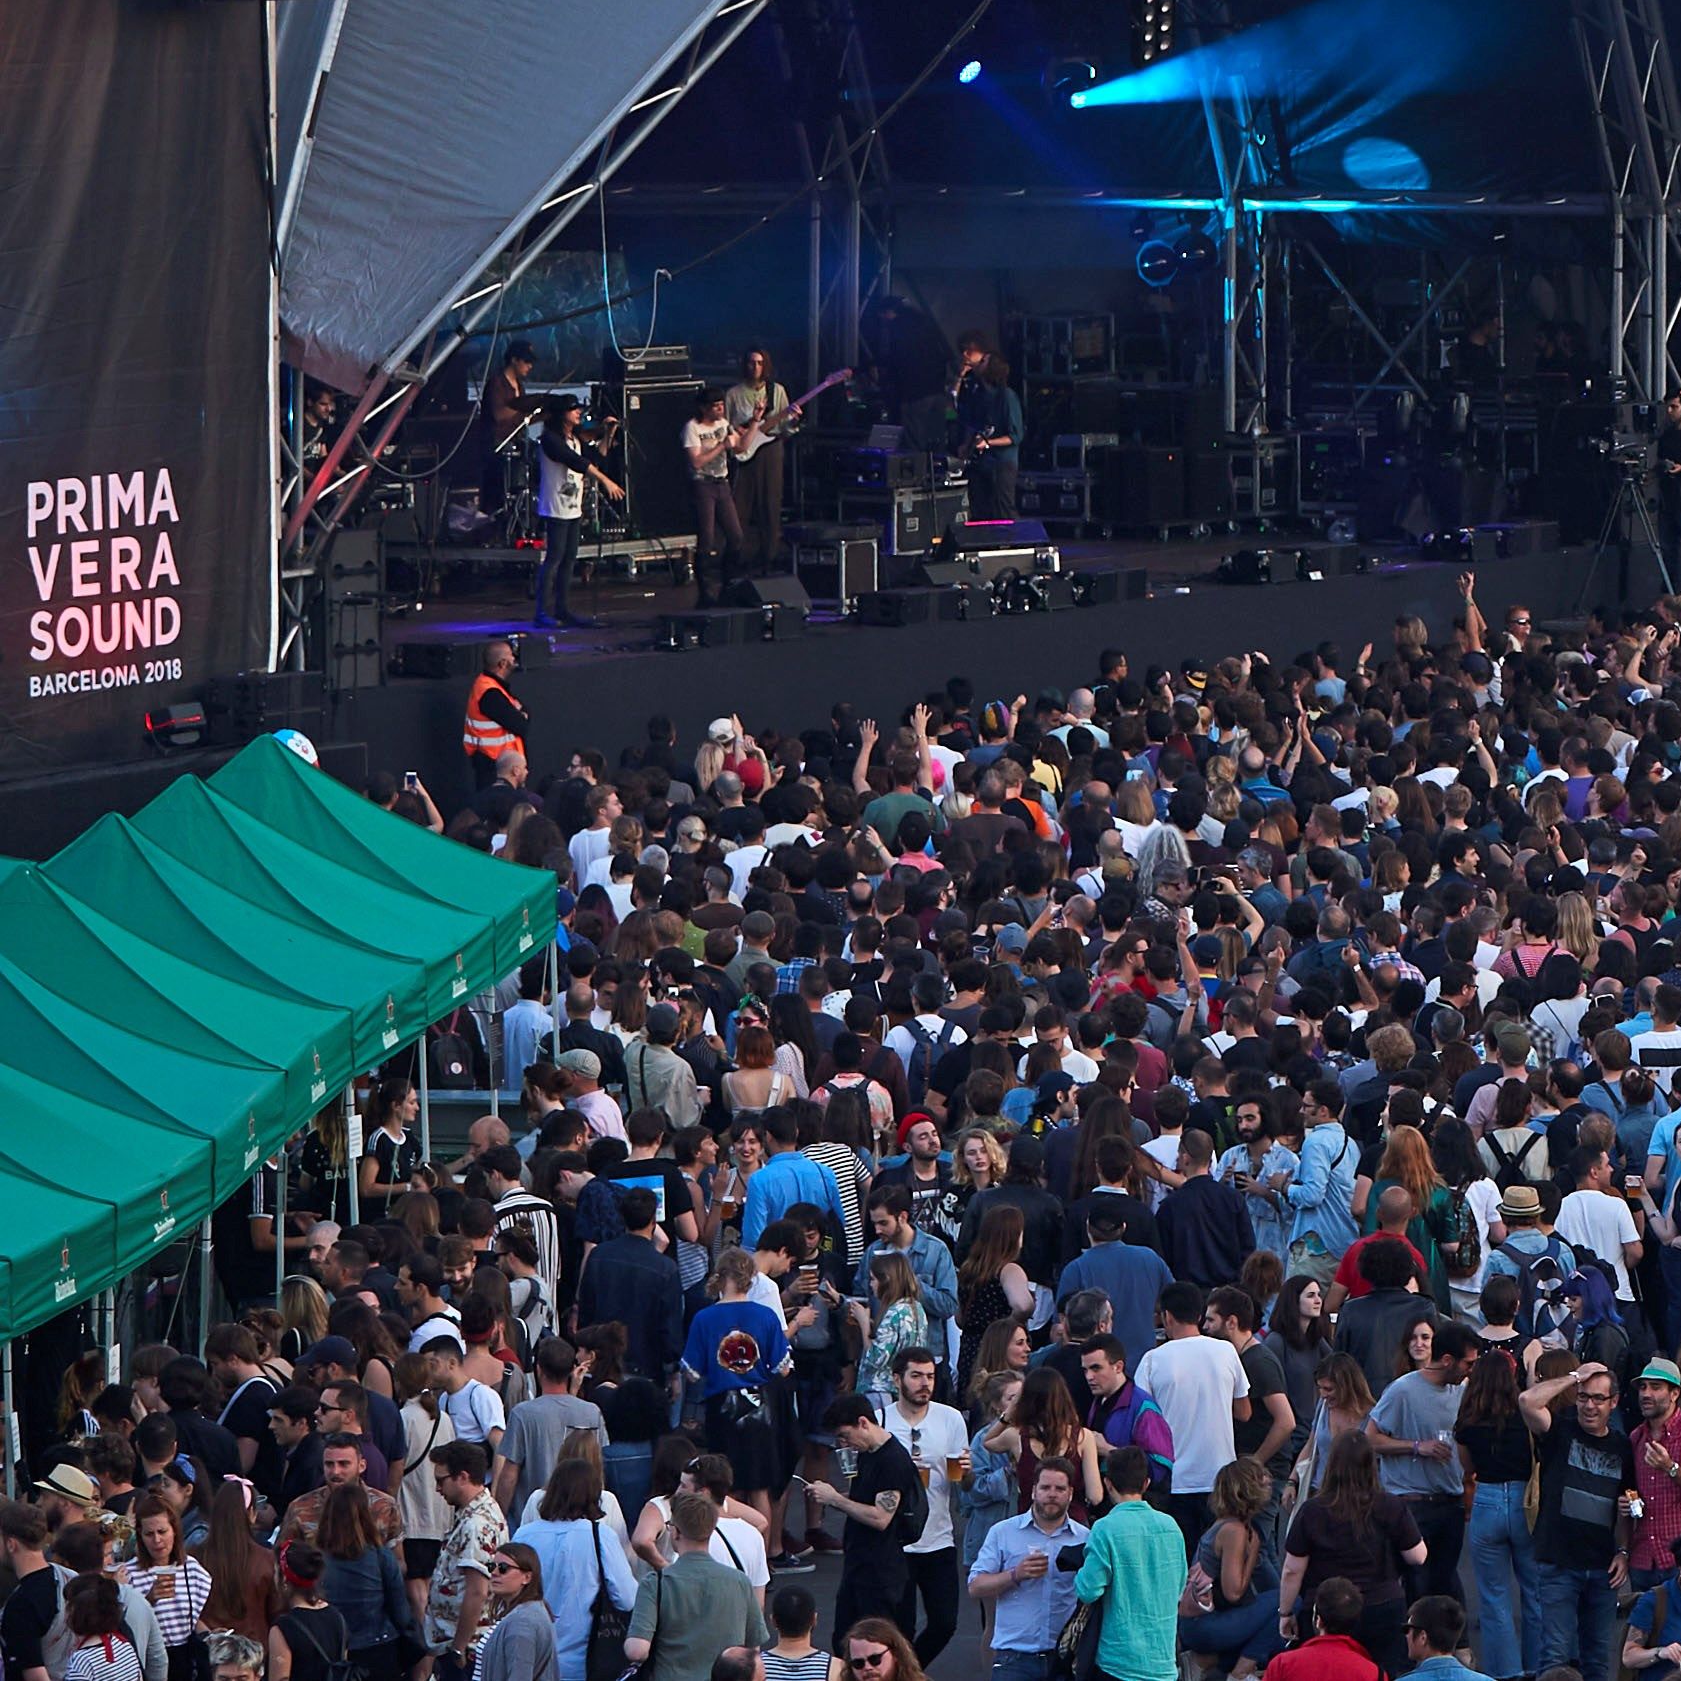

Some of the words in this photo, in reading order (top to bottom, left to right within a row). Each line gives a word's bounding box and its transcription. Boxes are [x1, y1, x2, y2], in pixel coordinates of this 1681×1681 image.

[28, 468, 179, 538] PRIMA
[28, 531, 180, 601] VERA
[30, 596, 181, 661] SOUND
[30, 664, 140, 697] BARCELONA
[145, 658, 182, 684] 2018
